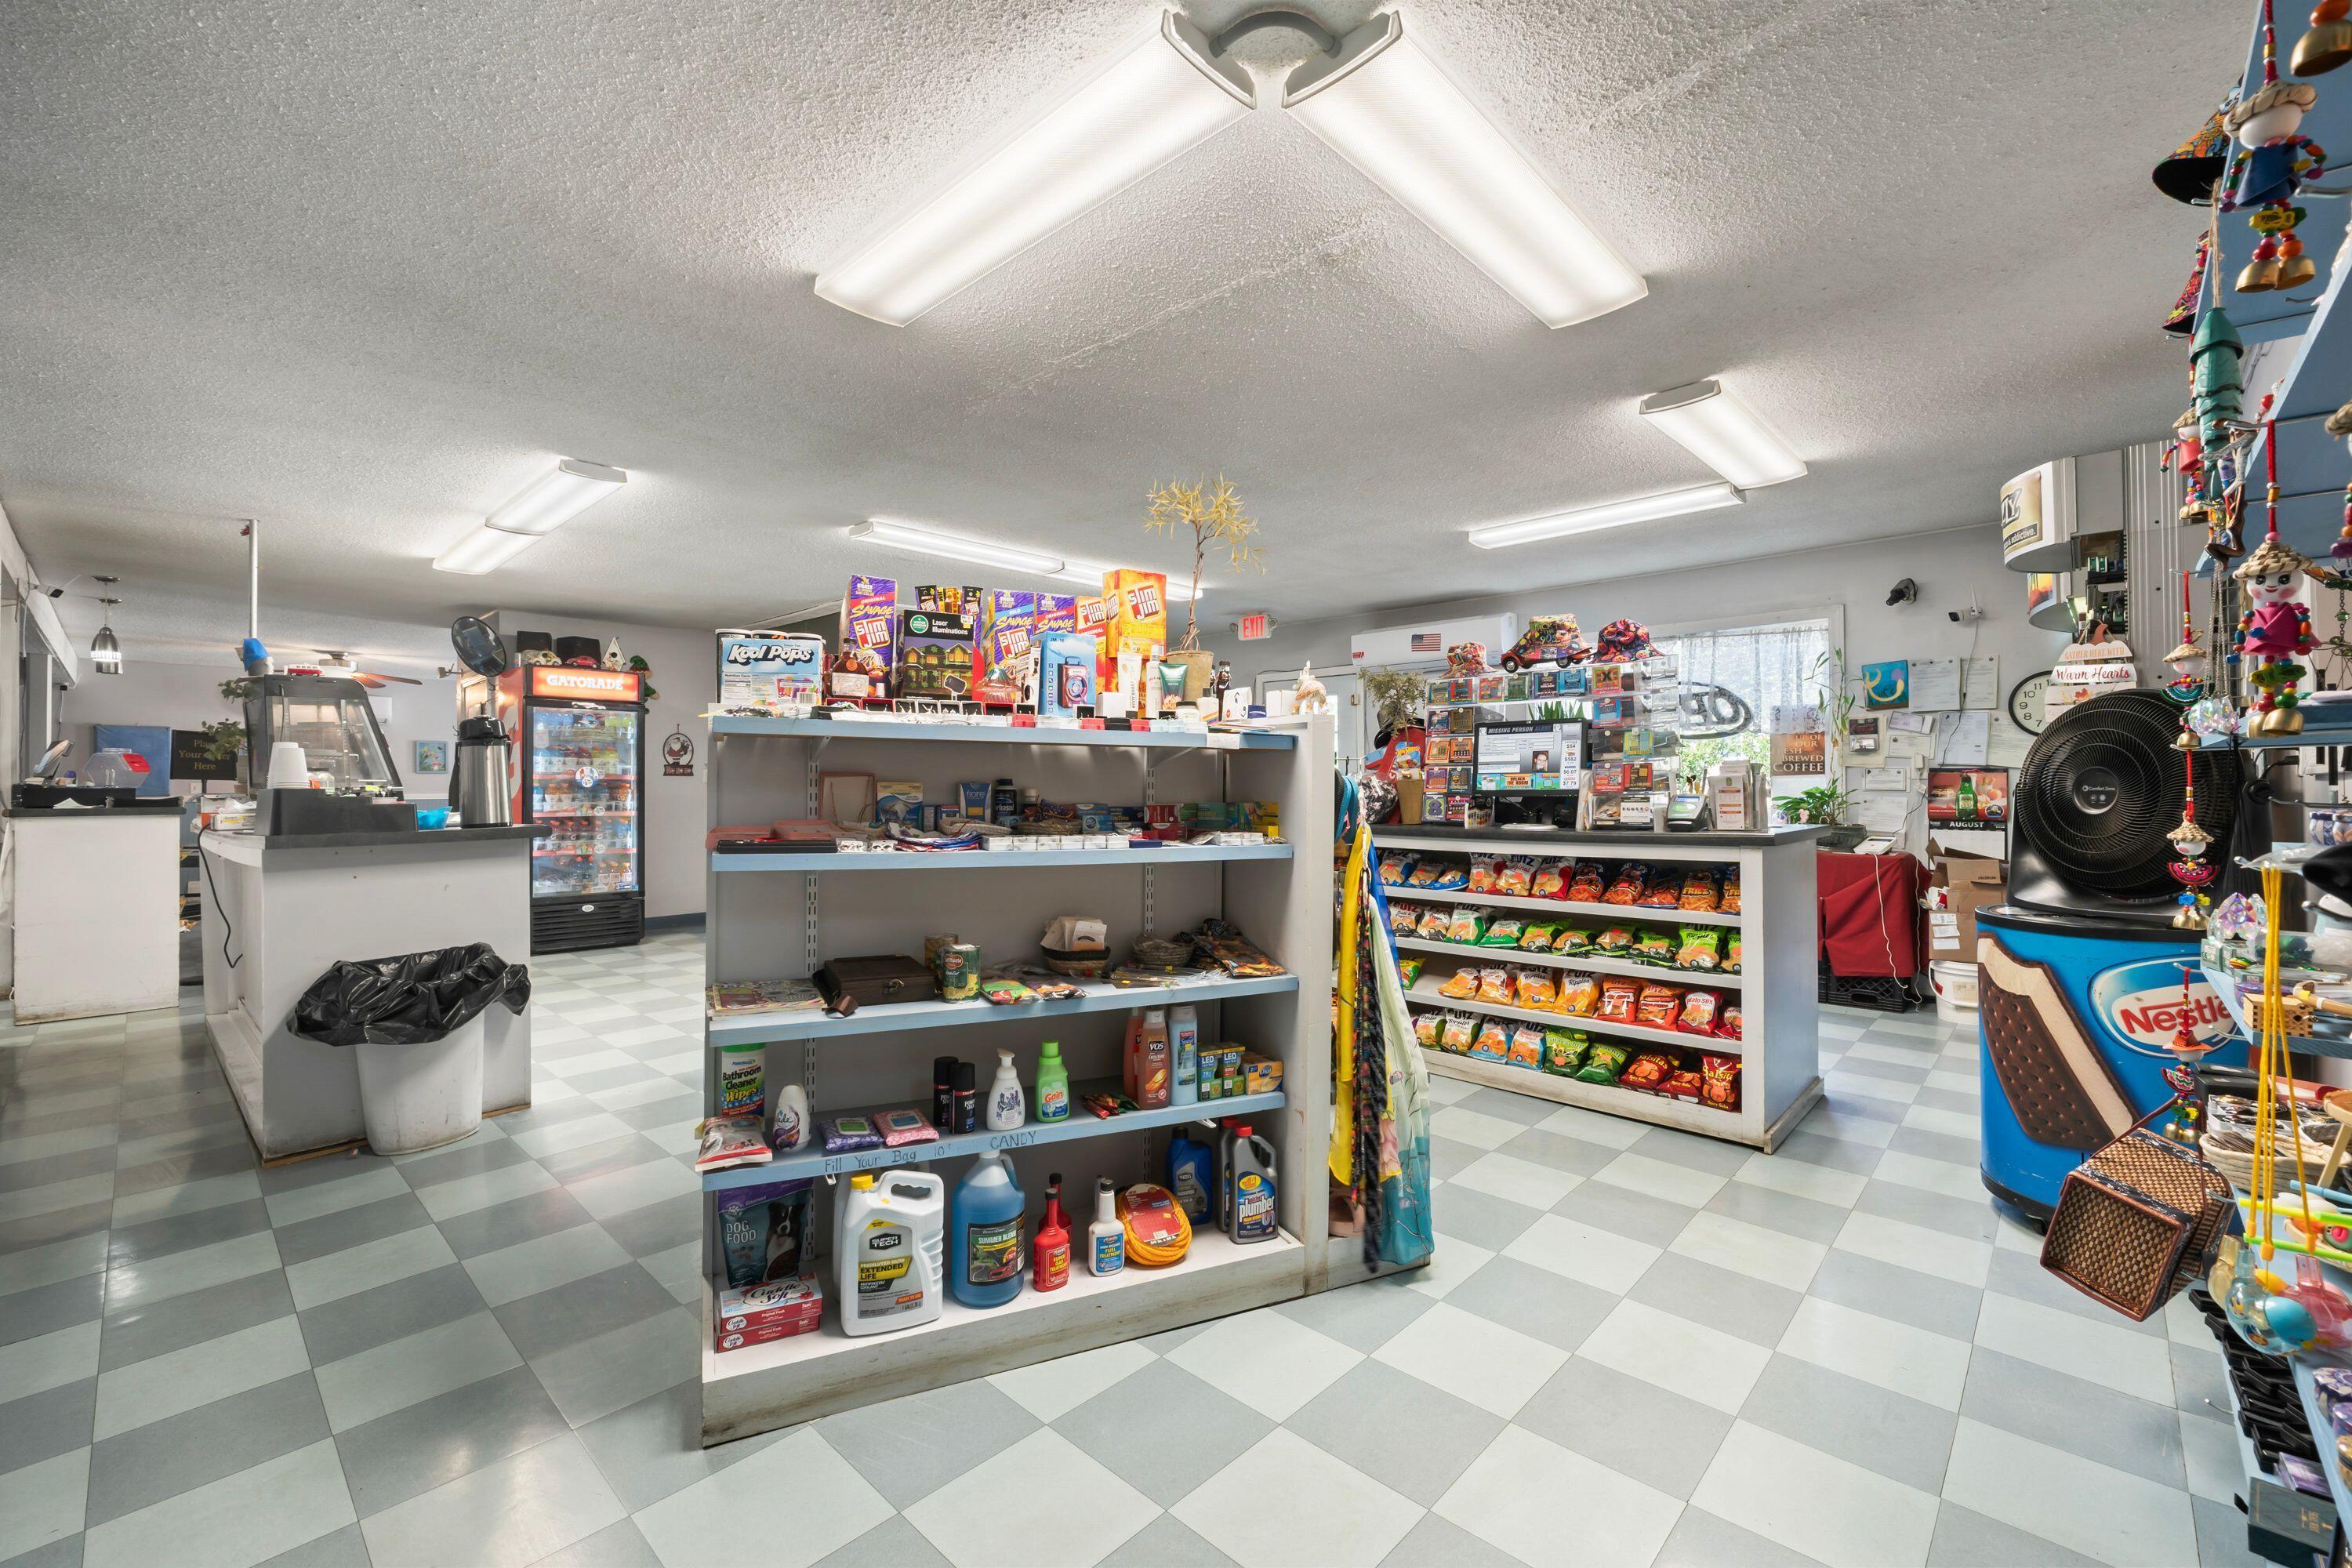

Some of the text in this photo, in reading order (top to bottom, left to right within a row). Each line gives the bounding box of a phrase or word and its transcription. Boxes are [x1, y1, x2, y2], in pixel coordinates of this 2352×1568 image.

[2011, 528, 2036, 544] addictive.
[850, 604, 894, 619] SAVAGE
[994, 616, 1033, 630] SAVAGE
[1036, 619, 1075, 633] SAVAGE
[1243, 616, 1265, 637] EXIT
[932, 626, 968, 635] Illuminations
[728, 644, 815, 665] Kool Pops
[2064, 647, 2125, 660] GATHER HERE WITH
[2056, 666, 2130, 681] Warm Hearts
[546, 675, 623, 691] GATORADE
[179, 750, 203, 759] Your
[1773, 763, 1824, 772] COFFEE
[966, 789, 985, 798] fiore
[722, 1066, 761, 1081] Bathroom
[1703, 1065, 1733, 1080] Salsit
[726, 1076, 757, 1090] Cleaner
[727, 1086, 758, 1102] Wipes
[1044, 1091, 1064, 1103] Gain
[825, 1160, 842, 1173] Fill
[855, 1155, 881, 1169] Your
[891, 1150, 917, 1167] Bag
[989, 1130, 1036, 1150] CANDY
[1239, 1196, 1275, 1222] plumber
[726, 1220, 750, 1233] DOG
[727, 1229, 757, 1244] FOOD
[860, 1263, 903, 1274] EXTENDED
[1050, 1262, 1068, 1272] TREATMENT
[750, 1283, 800, 1298] Cuddle
[760, 1291, 789, 1304] Soft
